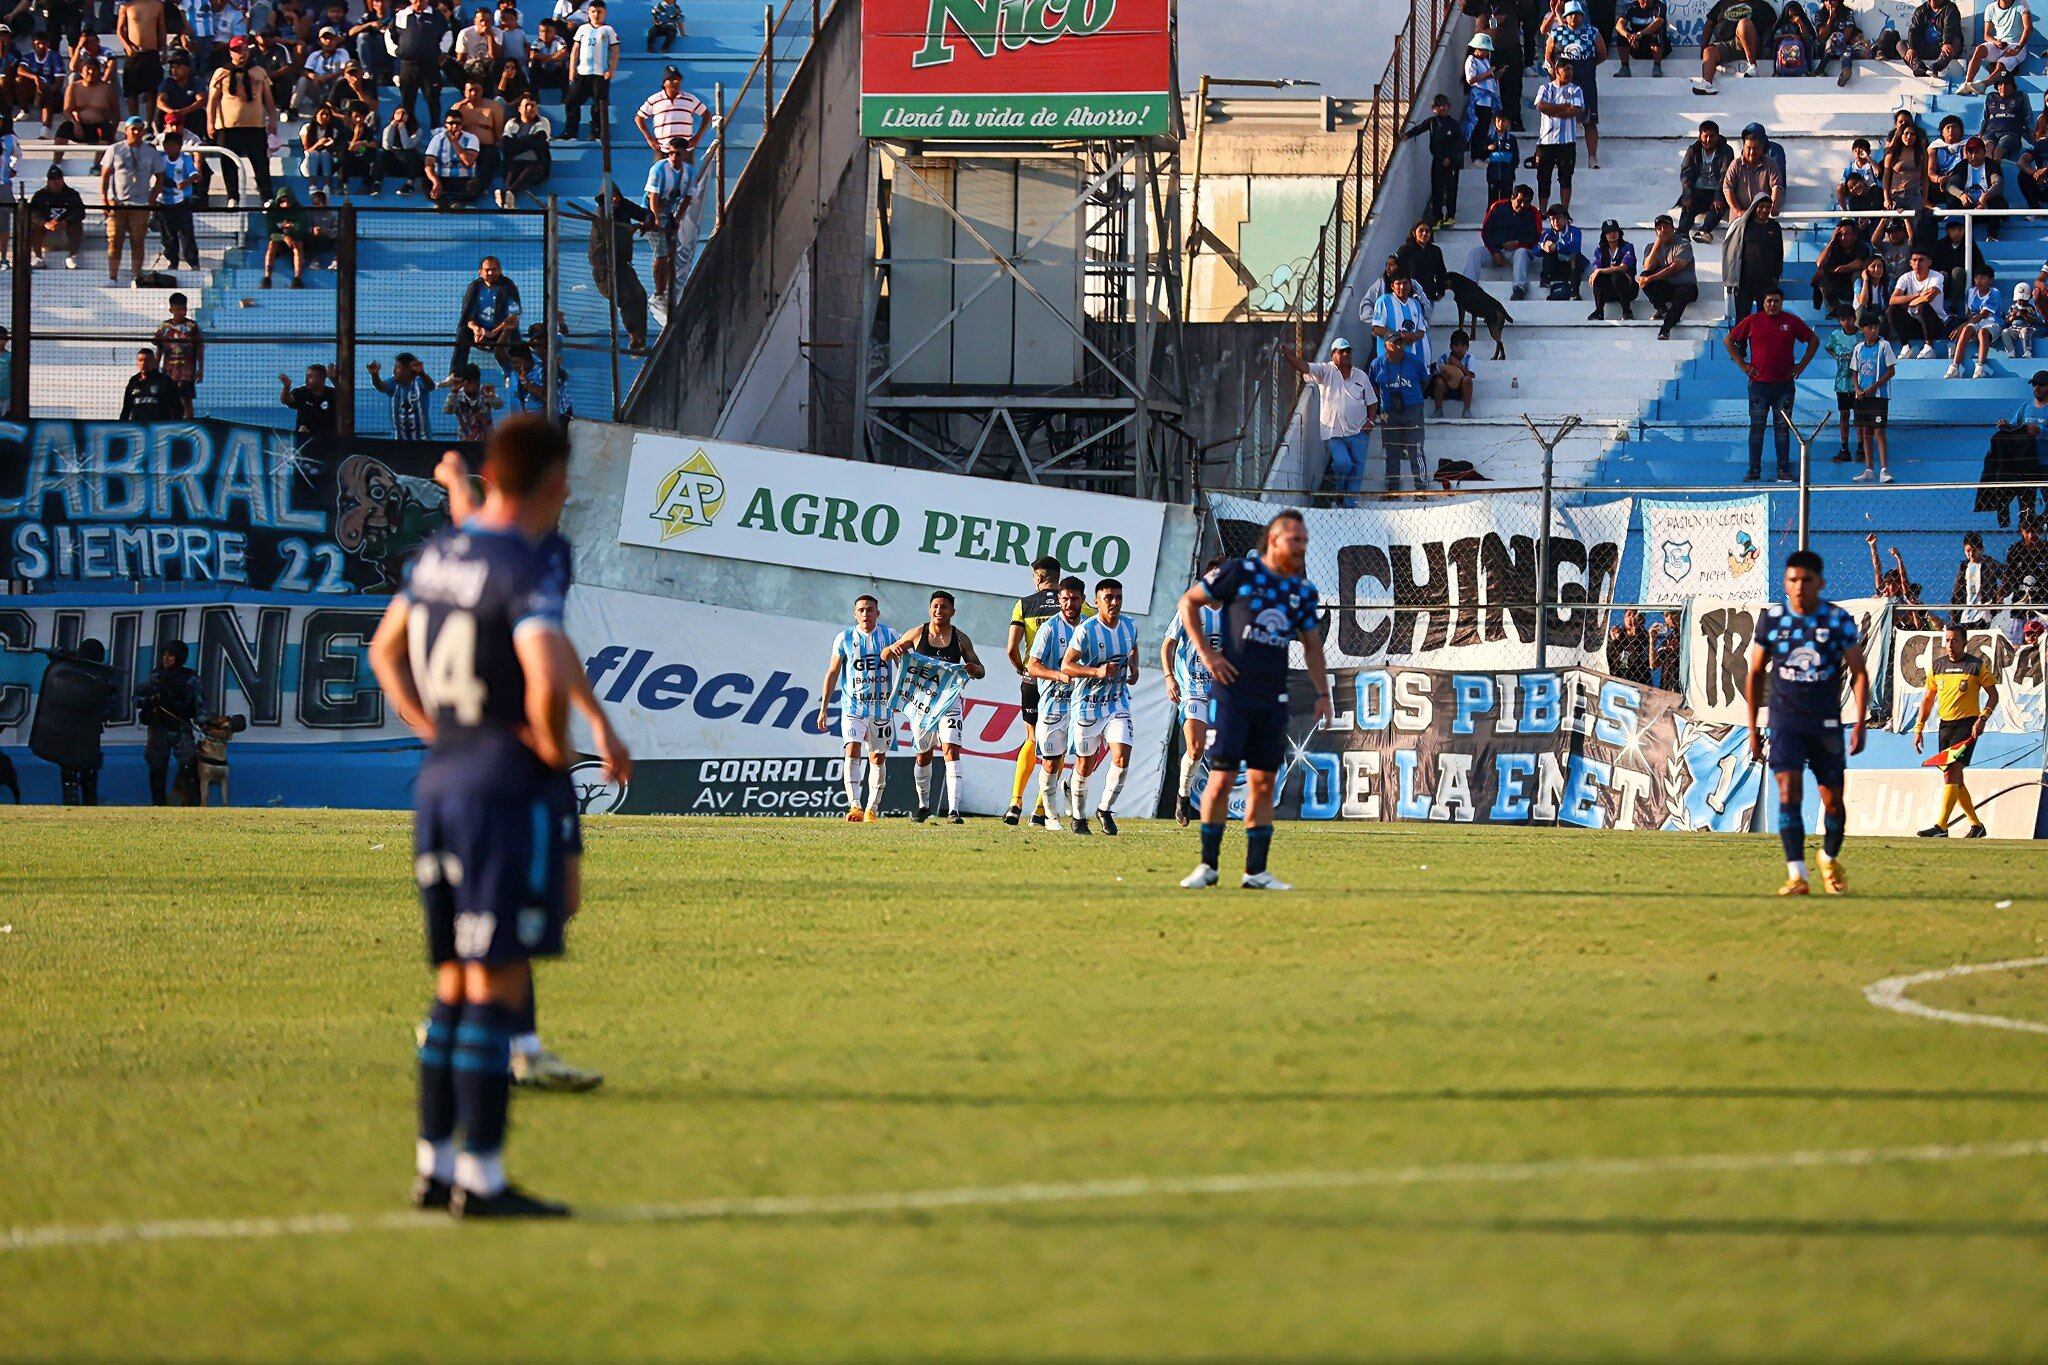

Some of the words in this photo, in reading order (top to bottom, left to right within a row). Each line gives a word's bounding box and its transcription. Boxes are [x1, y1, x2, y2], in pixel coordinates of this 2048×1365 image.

[880, 105, 943, 128] Llená
[948, 108, 971, 128] tu
[974, 107, 1025, 127] vida
[1029, 107, 1058, 127] de
[1063, 105, 1151, 127] Ahorro!
[738, 487, 900, 546] AGRO
[919, 509, 1131, 578] PERICO
[14, 523, 250, 584] SIEMPRE
[274, 537, 357, 593] 22
[406, 602, 490, 727] 14
[853, 659, 889, 672] GEA
[907, 665, 939, 687] GEA
[856, 676, 890, 685] BANCOR
[904, 677, 938, 698] BANCOR
[1318, 669, 1434, 732] LOS
[1452, 669, 1642, 747] PIBES
[876, 725, 892, 739] 10
[947, 718, 963, 732] 20
[692, 786, 734, 809] Av
[742, 786, 864, 809] Foresta
[1300, 750, 1382, 821] DE
[1394, 749, 1476, 823] LA
[1490, 752, 1651, 831] ENET
